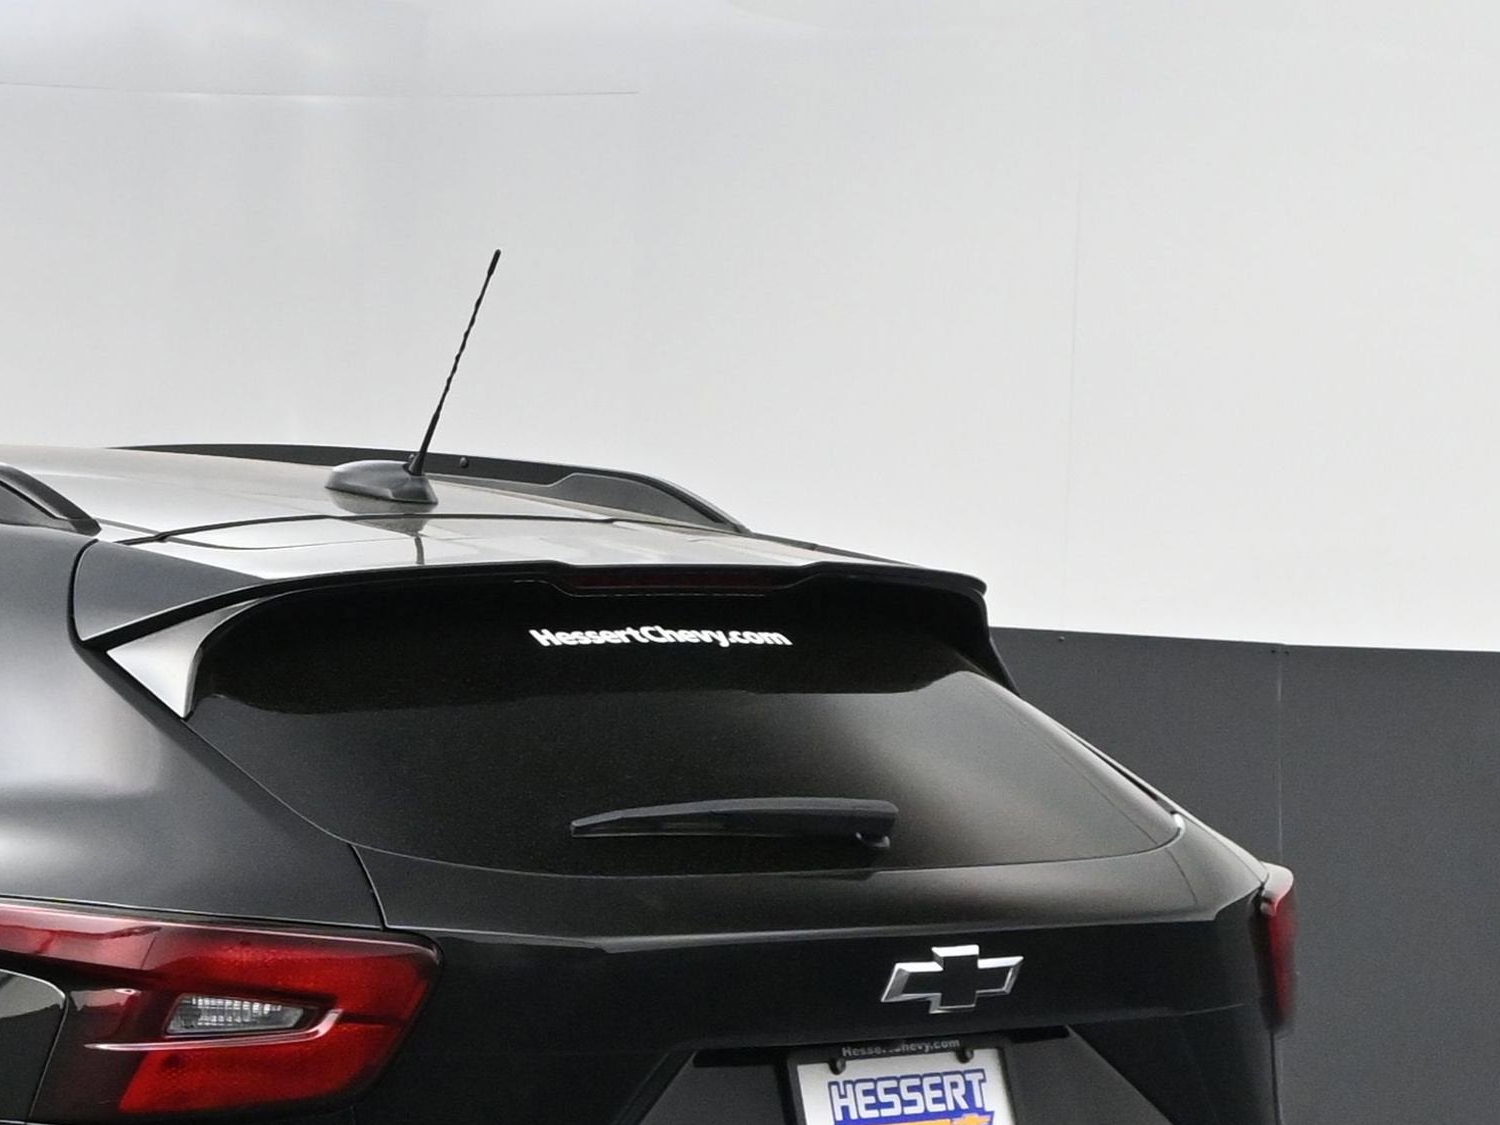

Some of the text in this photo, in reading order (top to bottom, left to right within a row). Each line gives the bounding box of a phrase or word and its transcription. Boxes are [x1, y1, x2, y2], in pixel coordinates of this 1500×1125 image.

[528, 625, 793, 648] HessertChevy.com
[841, 1039, 960, 1057] Hessehevy.com
[828, 1069, 987, 1121] HESSERT
